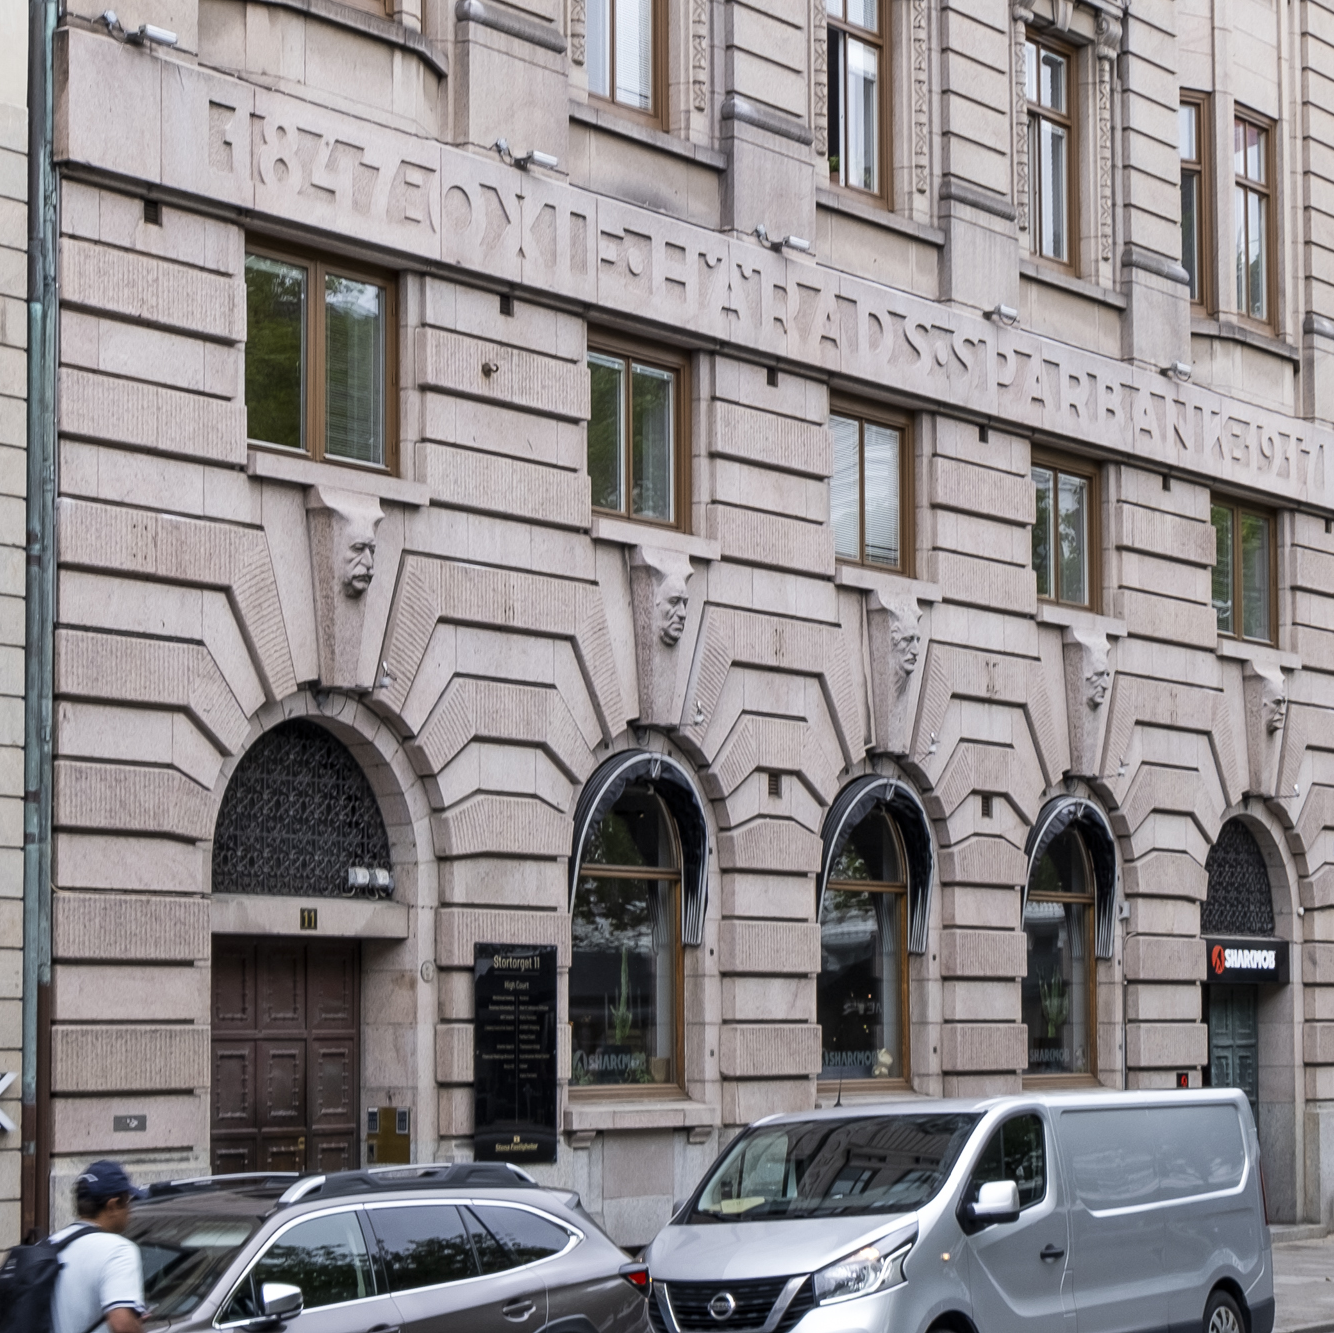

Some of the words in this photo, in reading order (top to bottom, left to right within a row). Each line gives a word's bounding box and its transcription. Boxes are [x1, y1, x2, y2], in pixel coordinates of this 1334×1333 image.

[303, 910, 315, 928] 11
[493, 955, 532, 972] Stortorget
[533, 956, 540, 970] 11
[1224, 948, 1276, 969] SHARKMOB
